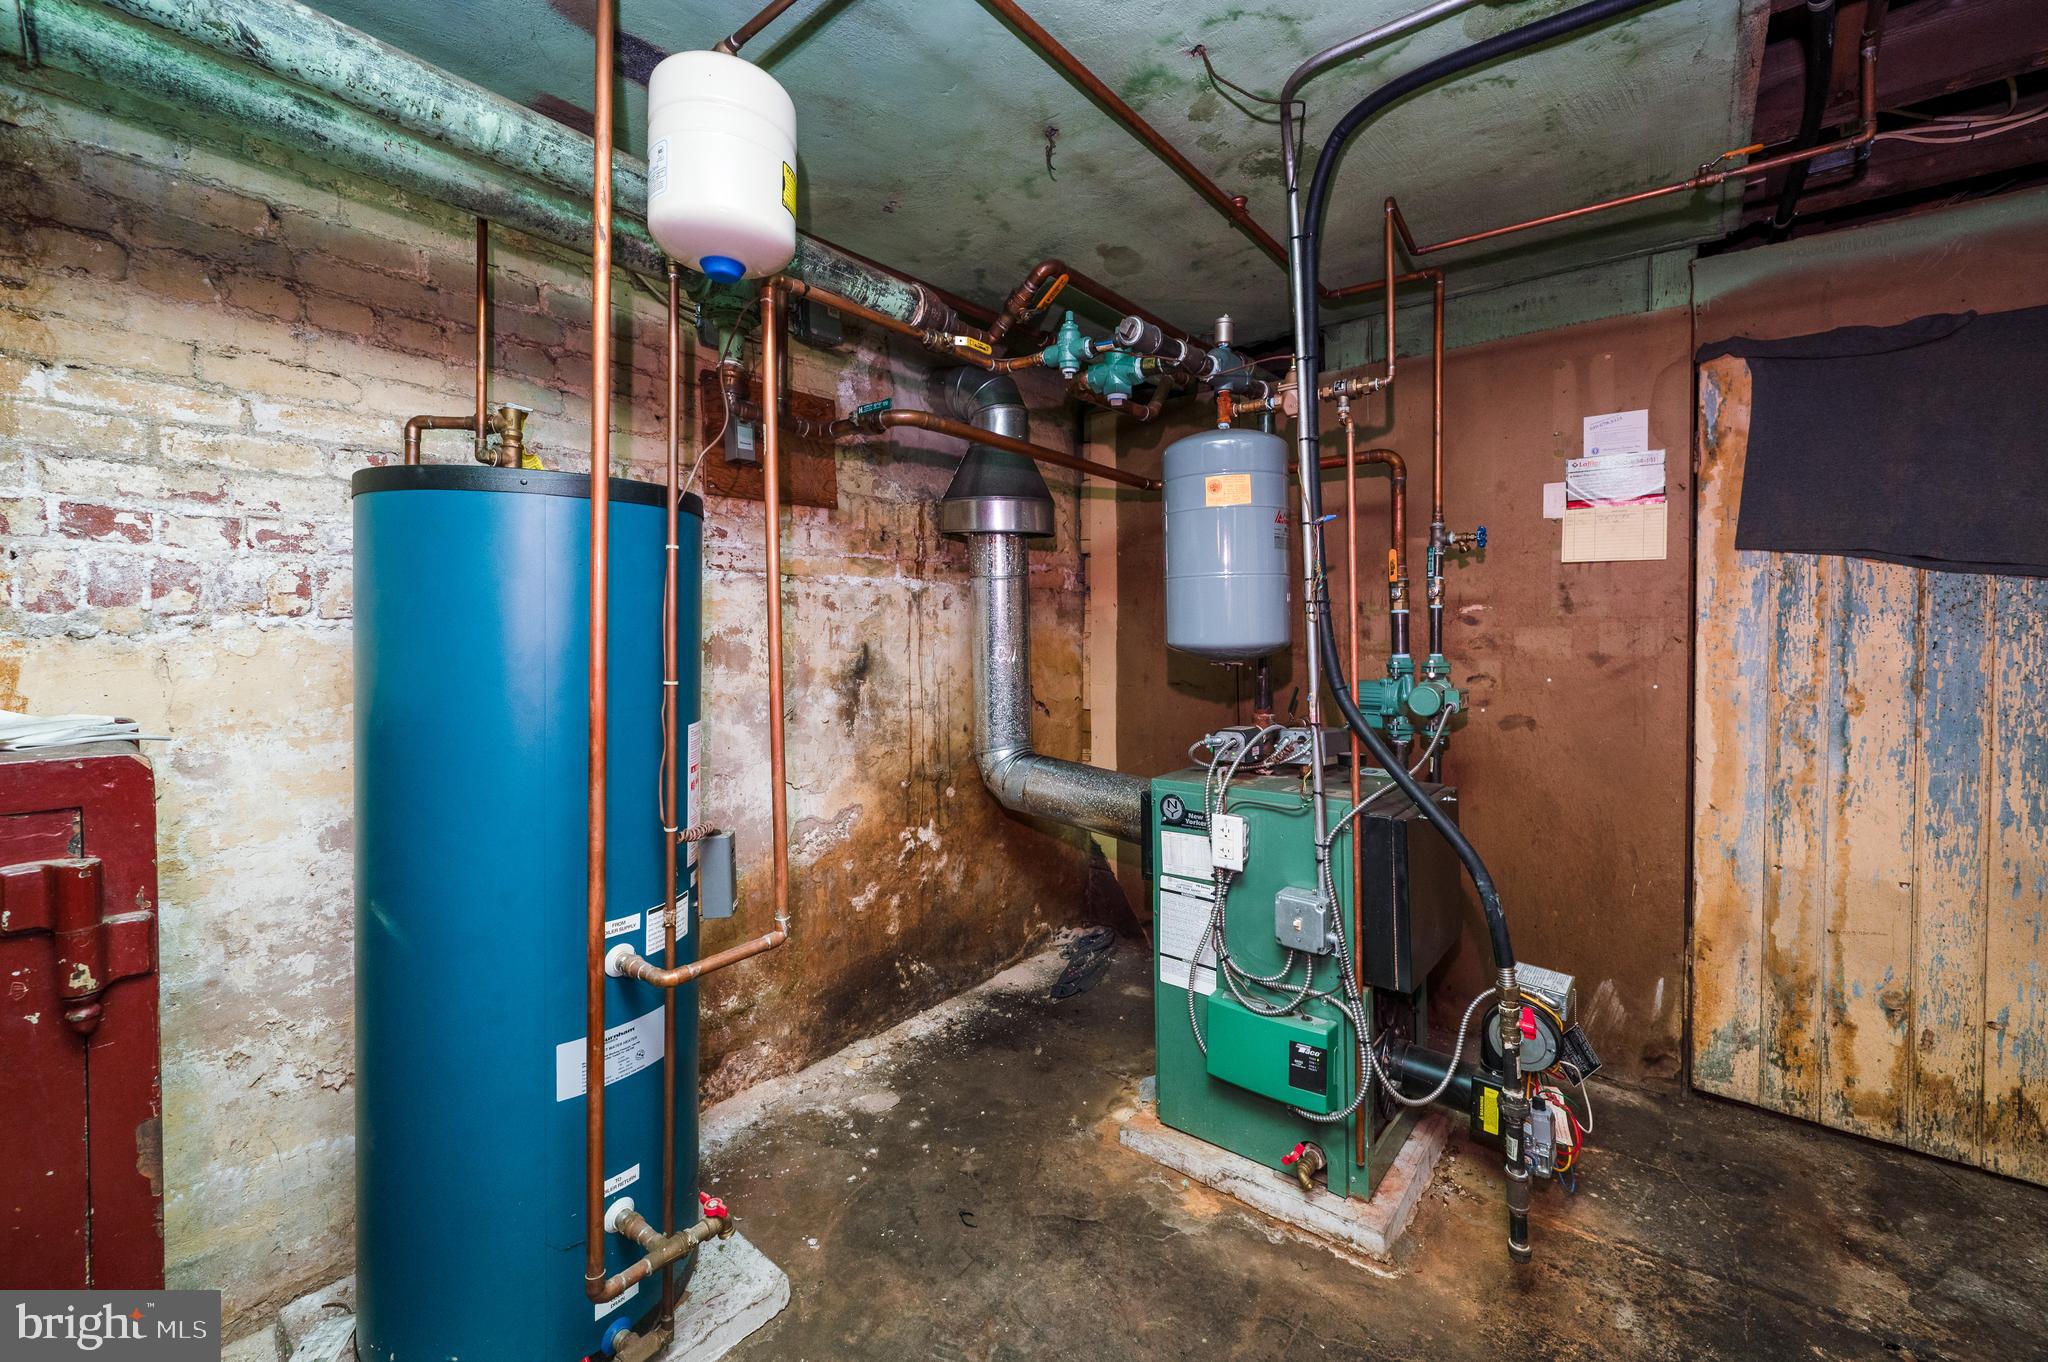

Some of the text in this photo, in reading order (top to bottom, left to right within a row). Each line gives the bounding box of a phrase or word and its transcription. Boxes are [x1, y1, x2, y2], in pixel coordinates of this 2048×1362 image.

[1187, 812, 1204, 820] New
[1184, 818, 1207, 827] Yorker
[611, 920, 627, 928] FROM
[618, 923, 637, 932] SUPPLY
[604, 1026, 635, 1042] urnham
[1296, 1043, 1321, 1057] Taco
[617, 1174, 637, 1188] RETURN
